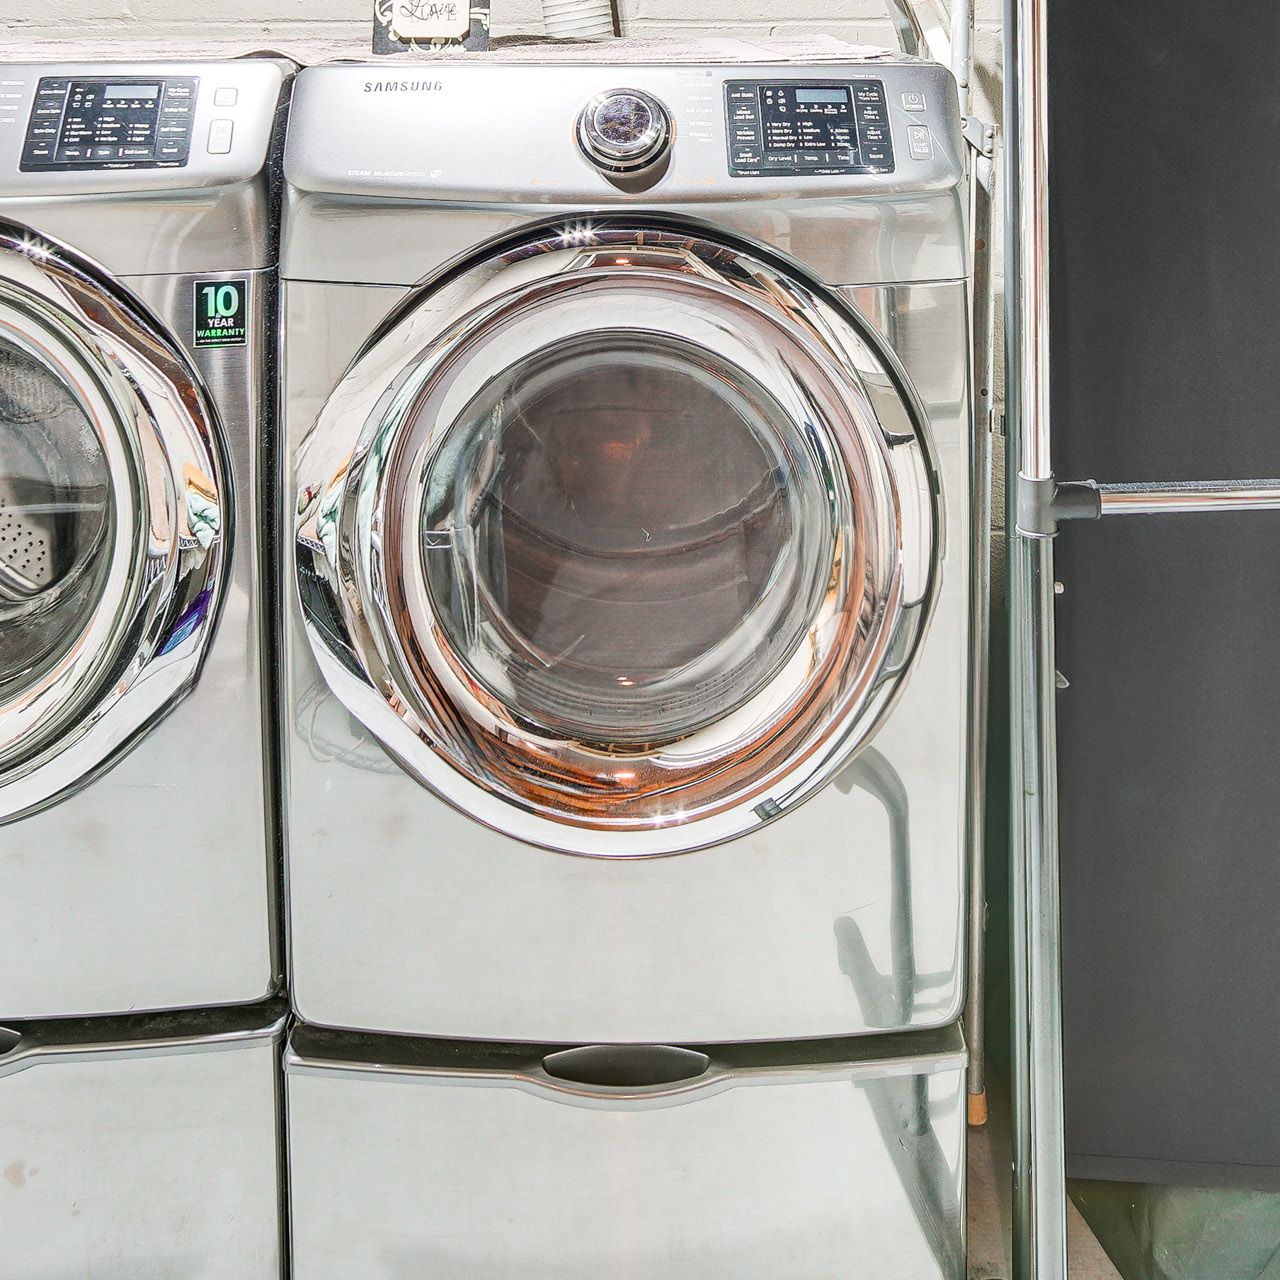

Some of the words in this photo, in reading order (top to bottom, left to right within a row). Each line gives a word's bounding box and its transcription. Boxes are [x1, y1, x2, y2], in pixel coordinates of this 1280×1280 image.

[363, 81, 444, 93] SAMSUNG
[202, 285, 238, 317] 10
[208, 318, 234, 327] YEAR
[197, 328, 245, 337] WARRANTY
